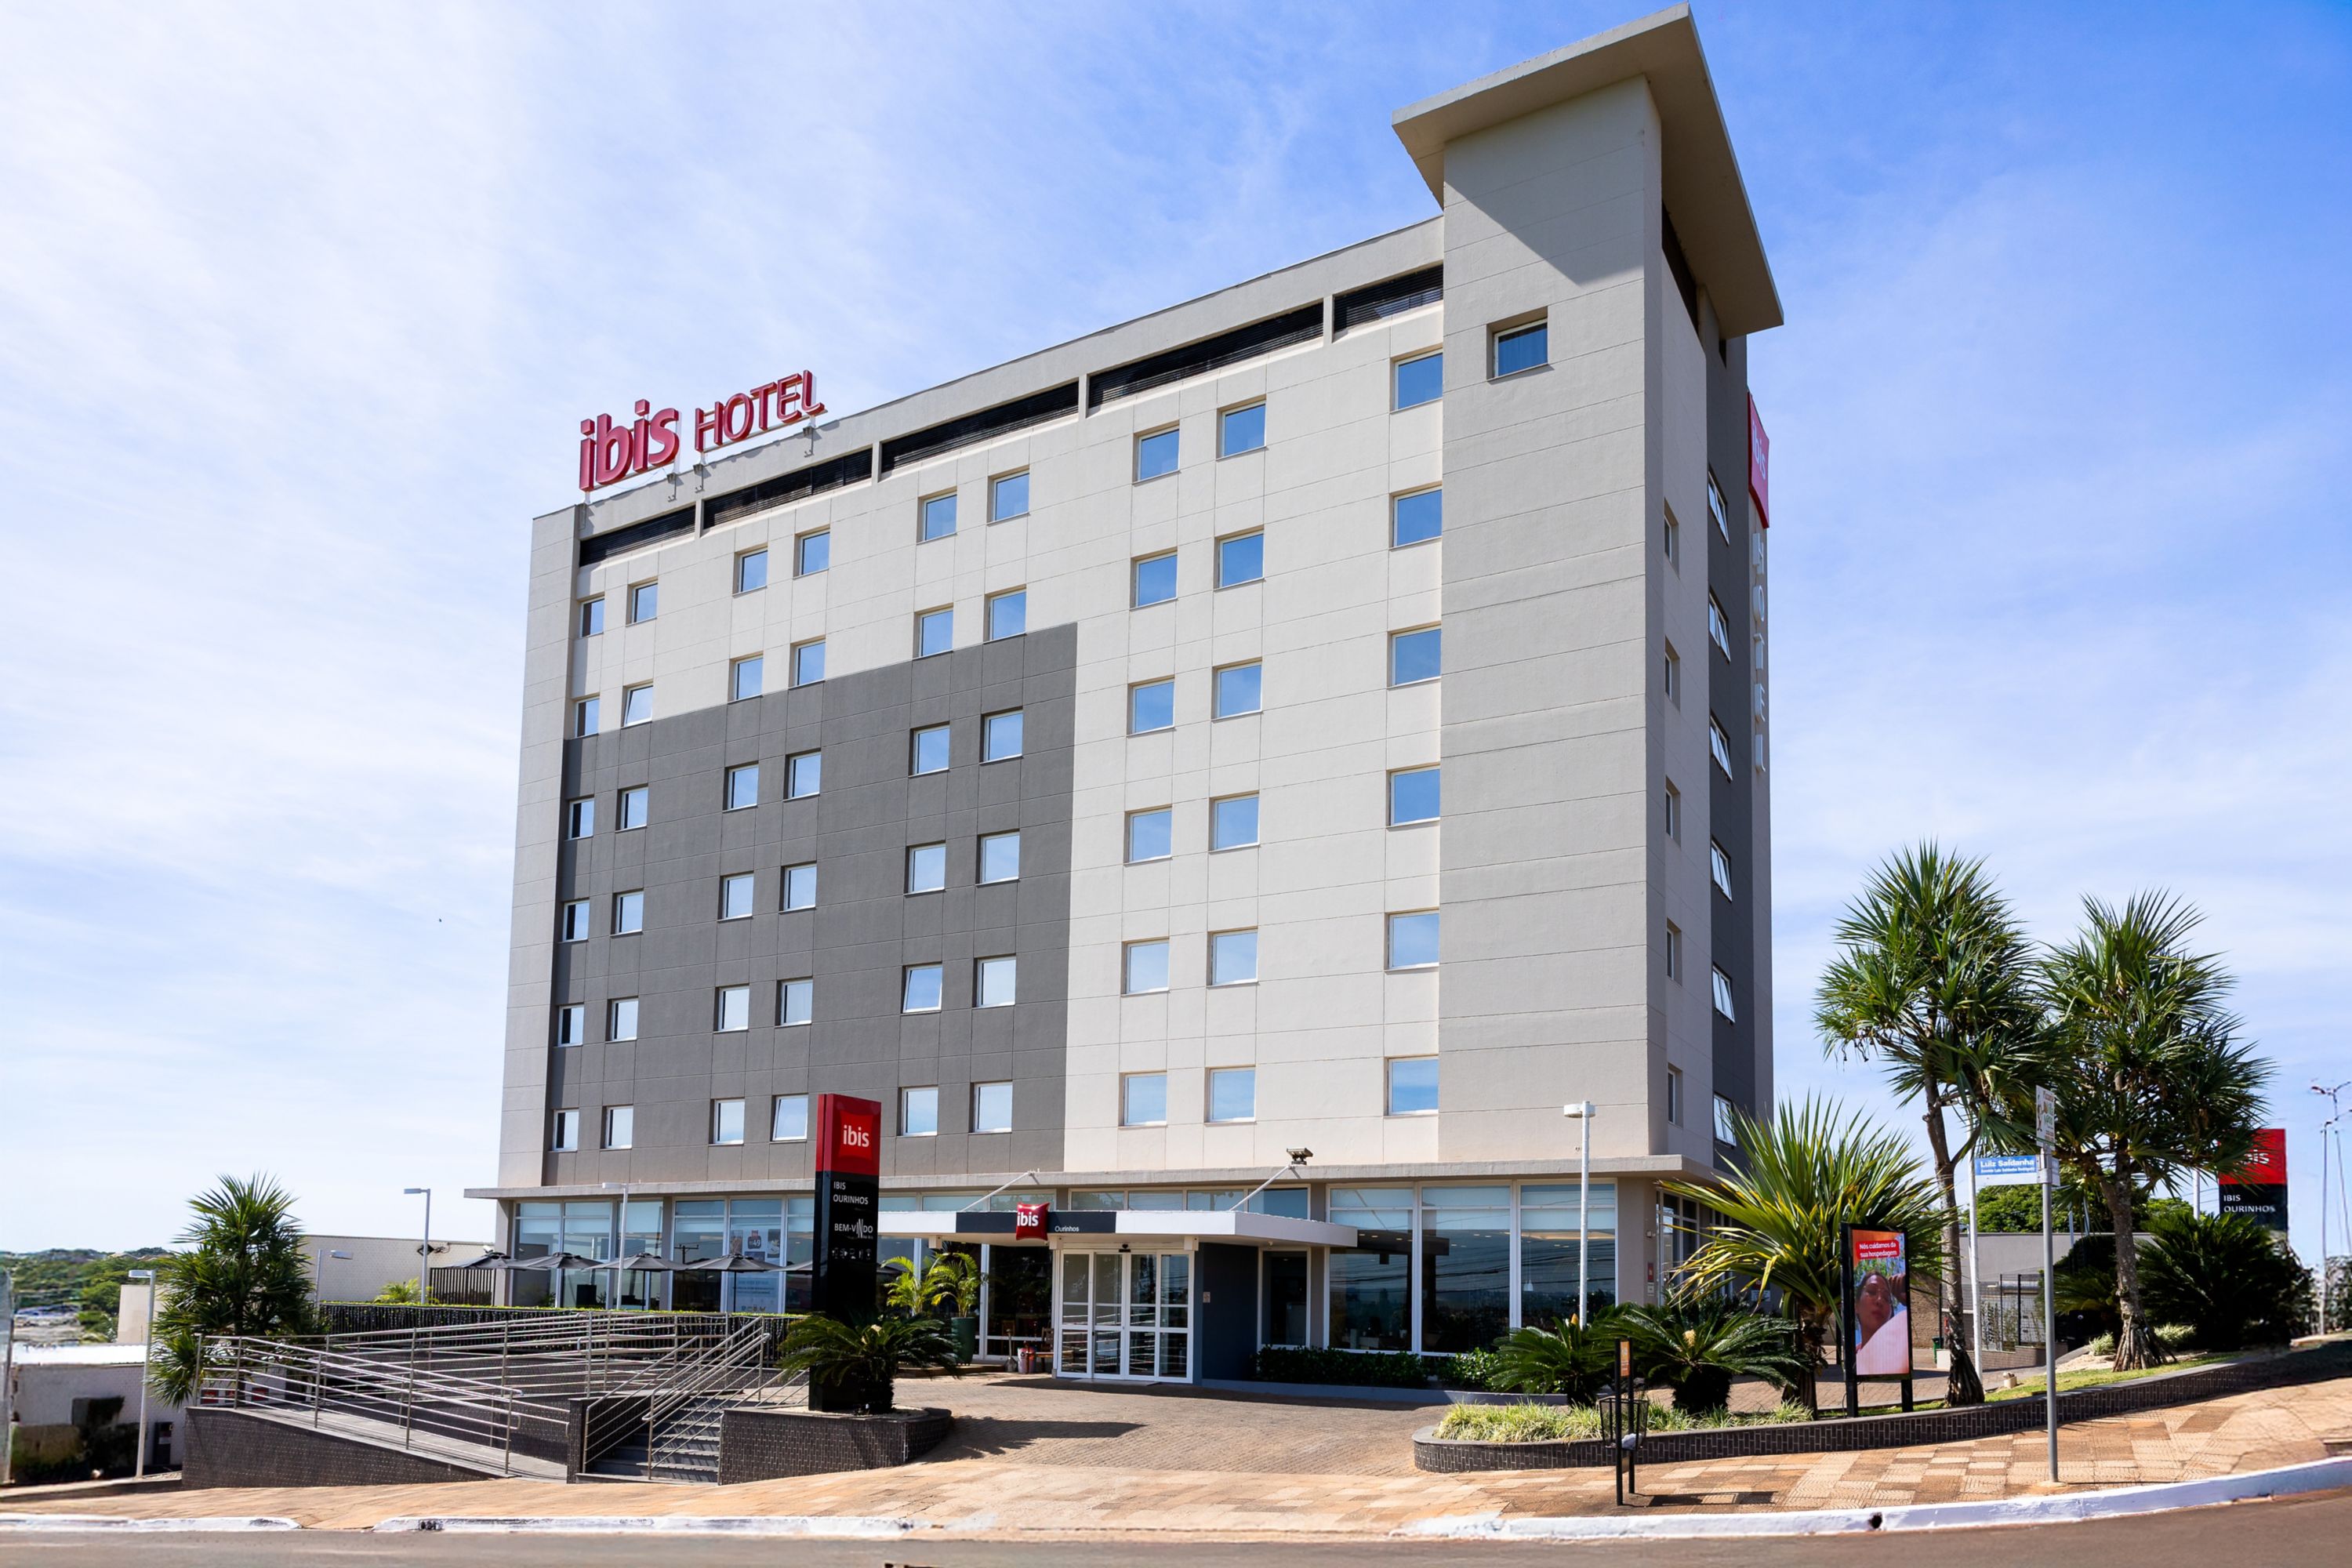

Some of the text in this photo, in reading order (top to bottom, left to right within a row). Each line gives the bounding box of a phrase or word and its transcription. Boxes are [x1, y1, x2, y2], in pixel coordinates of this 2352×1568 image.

[579, 369, 825, 492] ibis HOTEL
[1753, 419, 1766, 480] ibis
[1751, 532, 1766, 773] HOTEL
[843, 1124, 869, 1148] ibis
[833, 1181, 846, 1190] IBIS
[833, 1194, 869, 1205] OURINHOS
[1017, 1211, 1039, 1226] ibis
